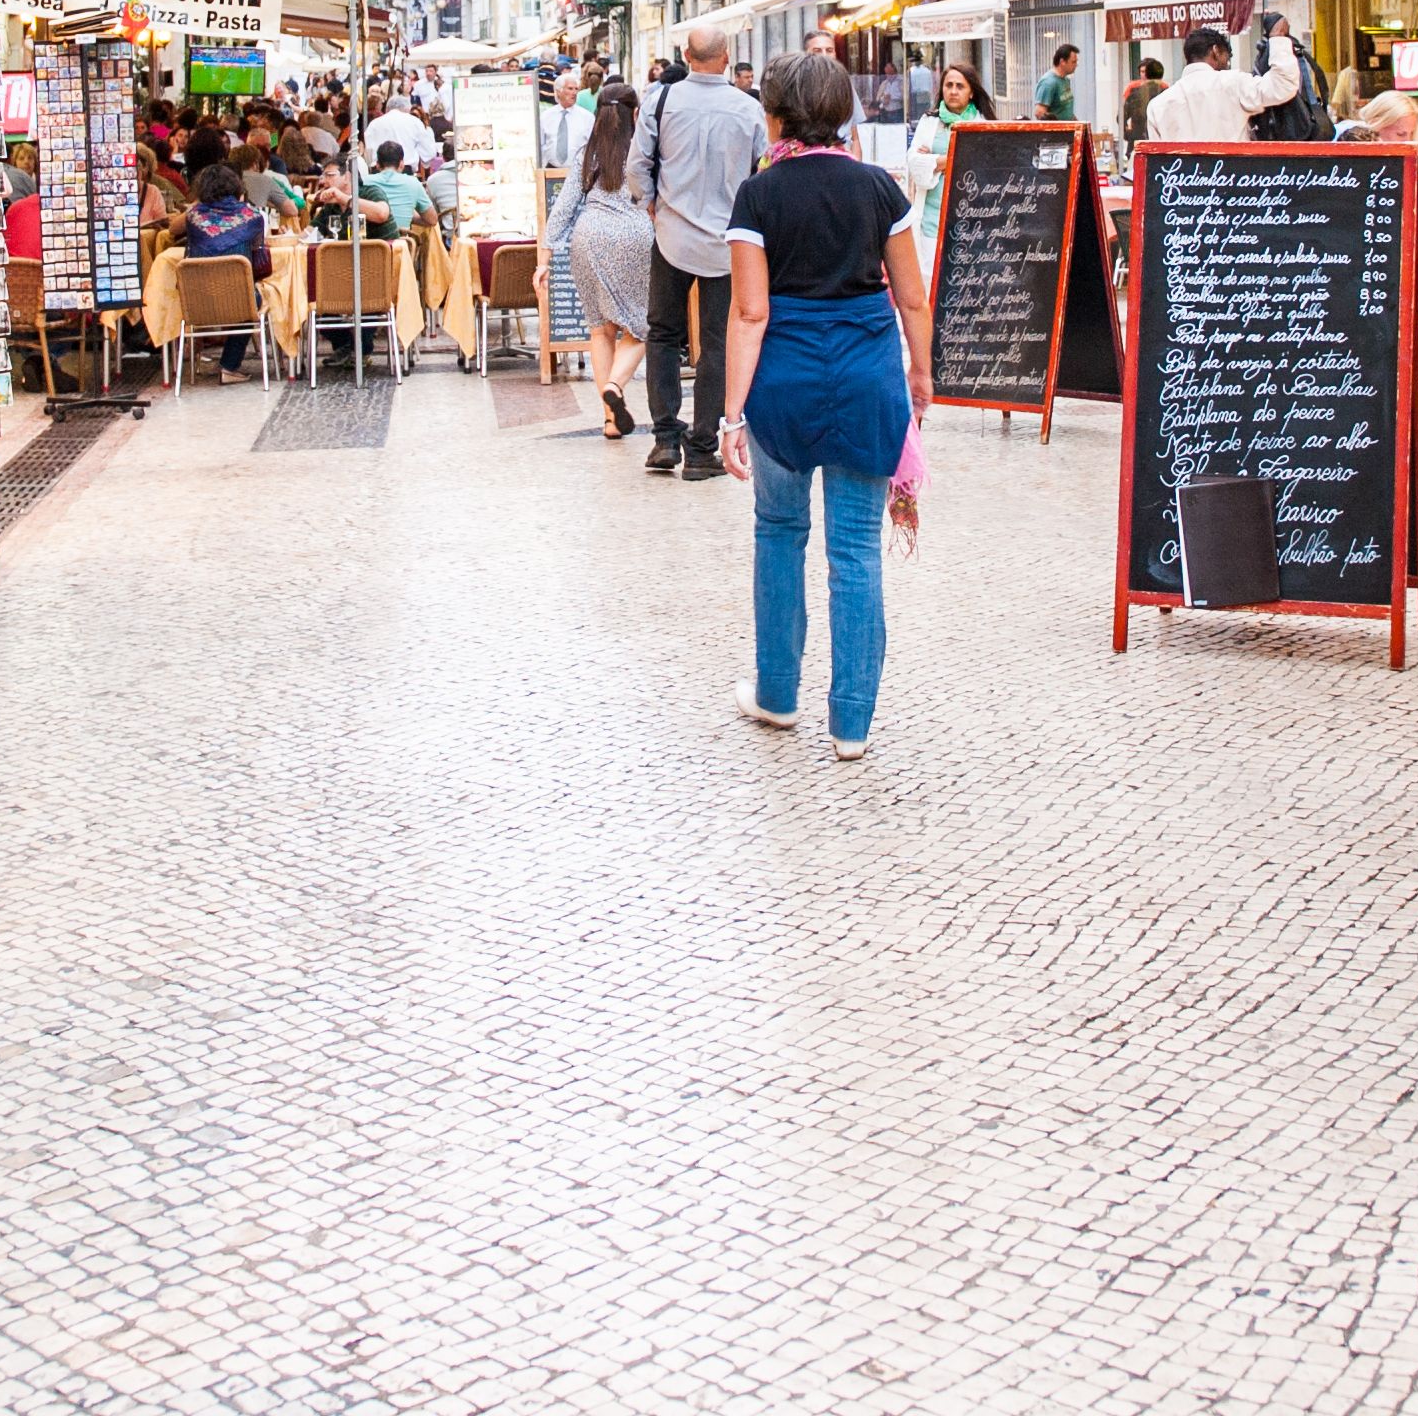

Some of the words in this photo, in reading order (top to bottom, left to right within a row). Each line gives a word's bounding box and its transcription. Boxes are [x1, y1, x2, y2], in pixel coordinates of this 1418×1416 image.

[206, 11, 261, 31] Pasta
[1131, 6, 1169, 24] TABERNA
[1172, 5, 1187, 22] DO
[1190, 2, 1224, 20] ROSSIO
[1132, 27, 1151, 39] SNACK
[1155, 158, 1235, 187] Sardinhas
[1236, 166, 1296, 187] assadas
[1160, 185, 1224, 206] Dourada
[1226, 188, 1292, 208] escalada
[1203, 227, 1219, 244] de
[1222, 268, 1238, 285] de
[1166, 284, 1228, 304] Bacalhau
[1299, 288, 1330, 310] grão
[1267, 321, 1349, 348] cataplana
[1199, 350, 1224, 372] da
[1159, 371, 1245, 407] Cataplana
[1254, 373, 1278, 399] de
[1283, 372, 1378, 398] Bacalhau
[1159, 399, 1243, 437] Cataplana
[1281, 401, 1335, 435] peixe
[1215, 427, 1242, 453] de
[1241, 430, 1297, 466] peixe
[1302, 433, 1333, 449] ao
[1335, 422, 1380, 451] alho
[1339, 537, 1382, 578] pato
